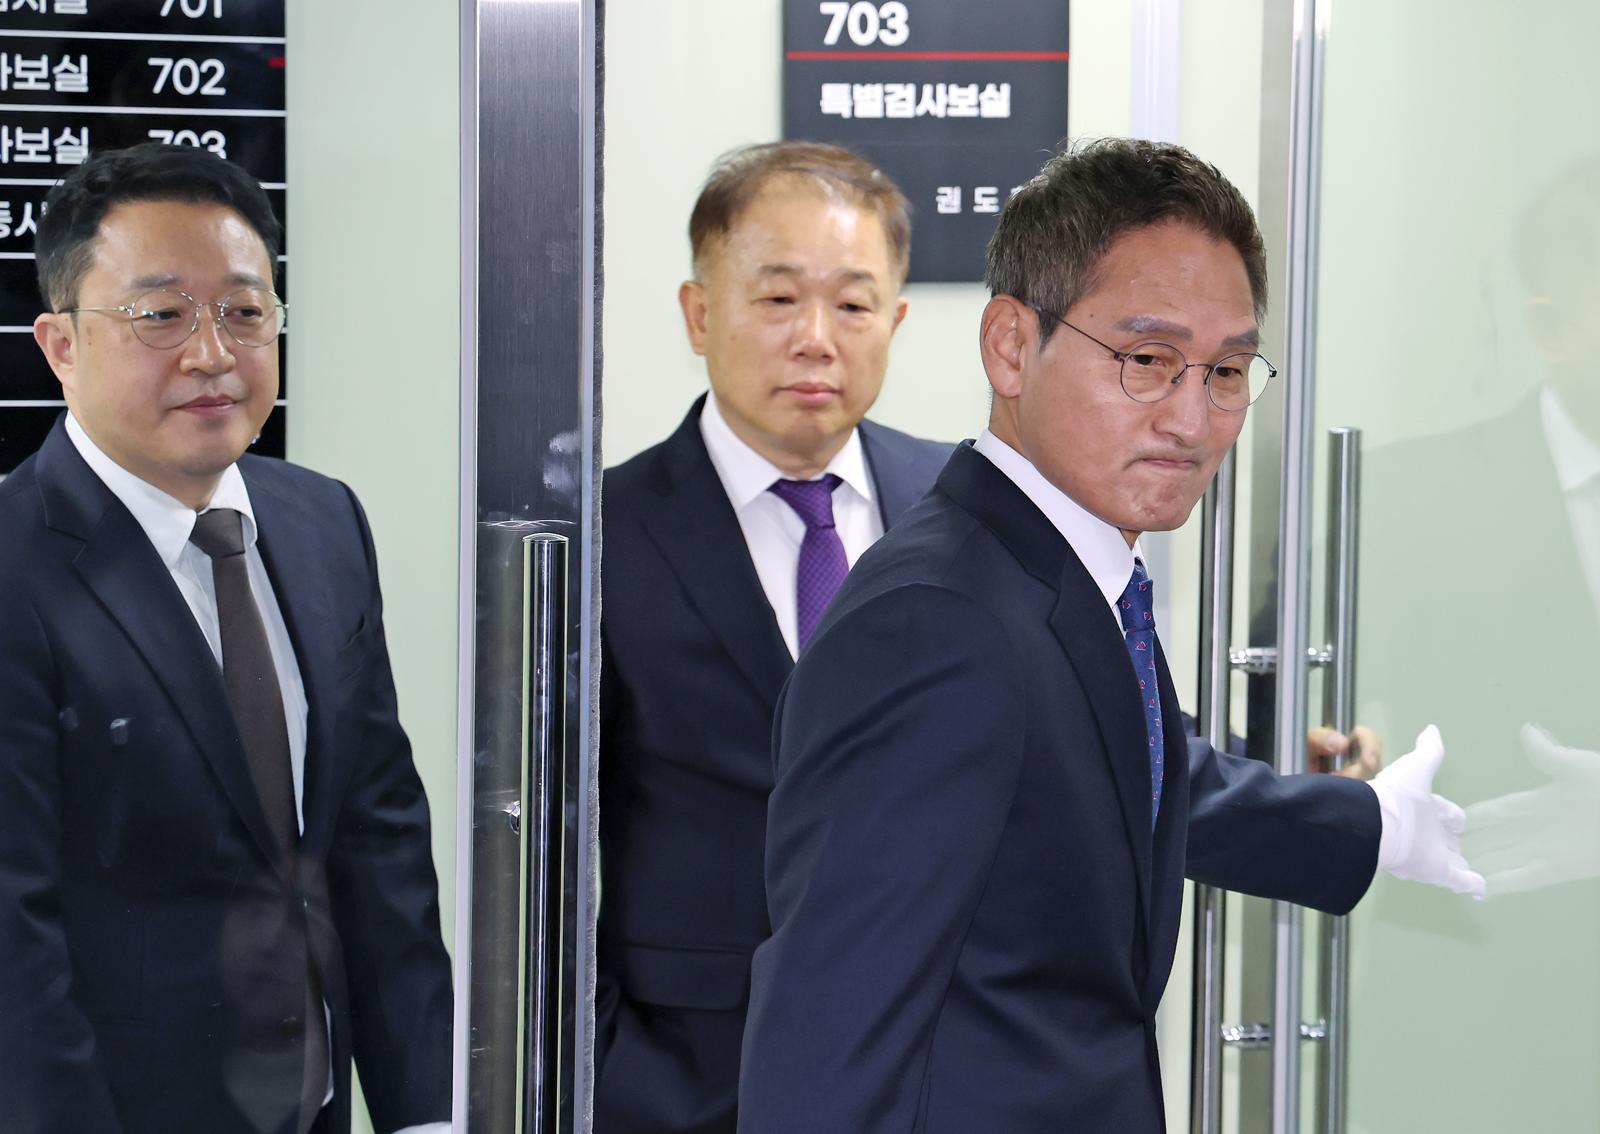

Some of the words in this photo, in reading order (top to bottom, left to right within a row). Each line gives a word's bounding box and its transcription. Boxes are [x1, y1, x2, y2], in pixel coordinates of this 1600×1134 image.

[819, 1, 910, 46] 703
[148, 57, 227, 96] 702
[820, 83, 1011, 118] 특별검사보실
